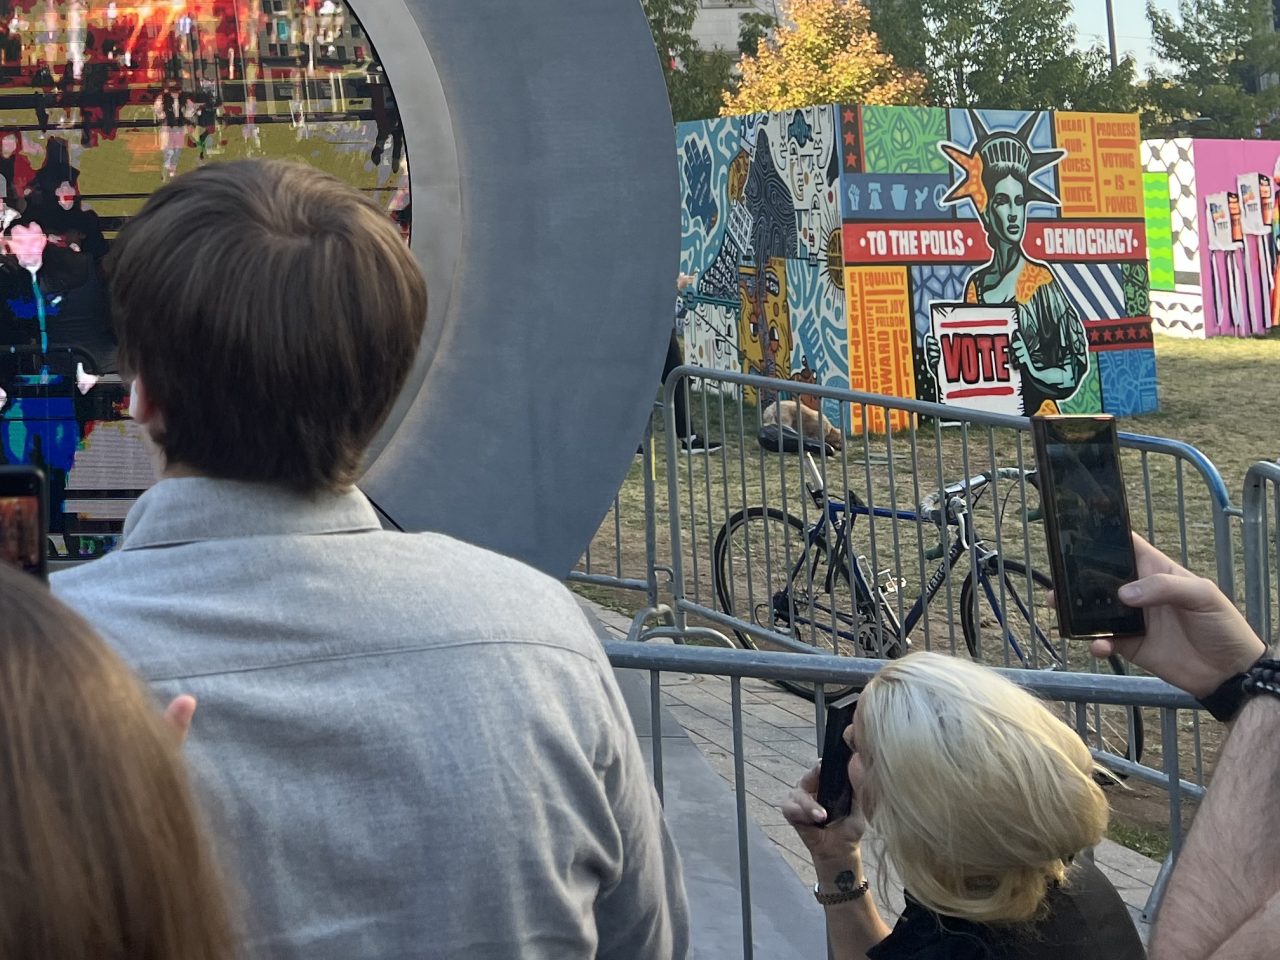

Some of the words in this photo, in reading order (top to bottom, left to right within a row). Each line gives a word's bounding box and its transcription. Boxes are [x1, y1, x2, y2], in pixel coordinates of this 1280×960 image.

[1096, 122, 1136, 137] PROGRESS
[1061, 158, 1091, 173] VOICES
[1101, 152, 1135, 169] VOTING
[1064, 186, 1093, 203] UNITE
[1105, 196, 1138, 213] POWER
[866, 230, 887, 256] TO
[889, 230, 918, 256] THE
[920, 229, 965, 256] POLLS
[1044, 227, 1133, 255] DEMOCRACY
[864, 271, 905, 288] EQUALITY
[890, 299, 905, 314] JOY
[940, 333, 1011, 384] VOTE
